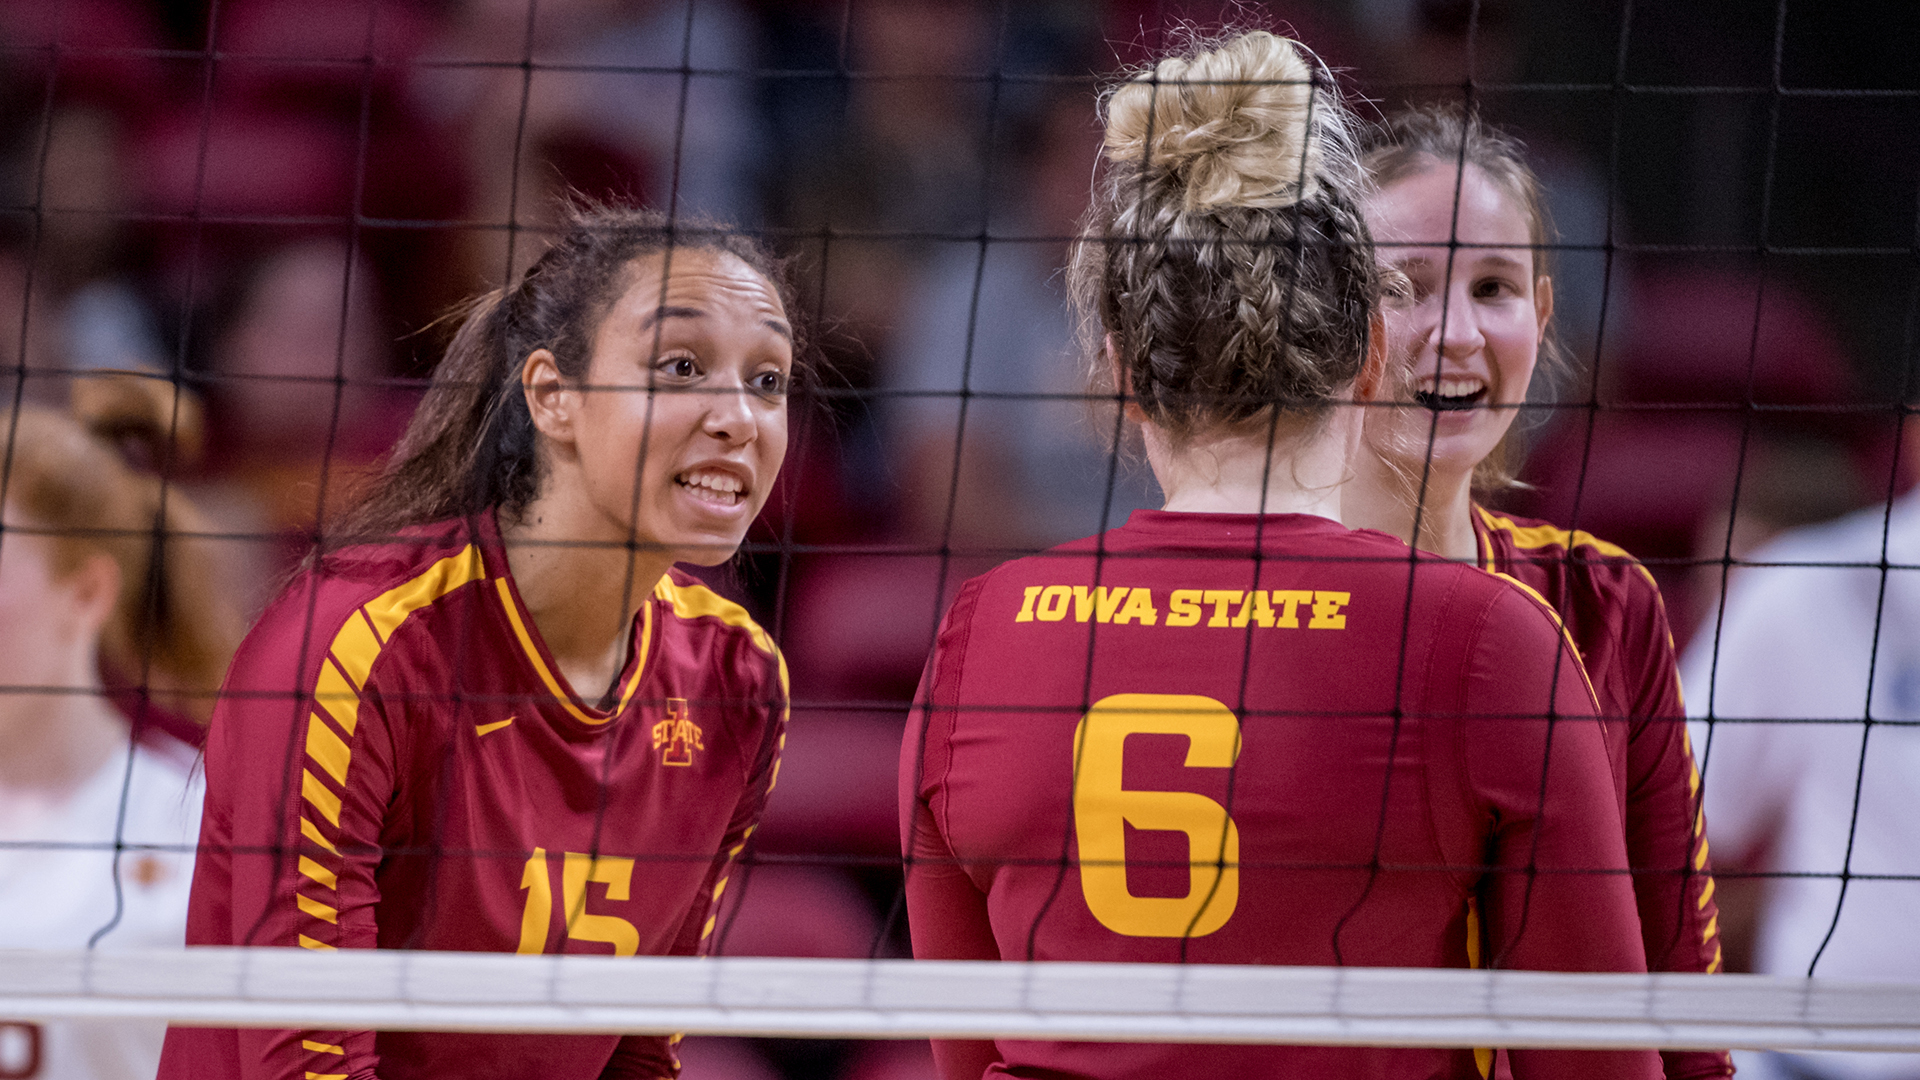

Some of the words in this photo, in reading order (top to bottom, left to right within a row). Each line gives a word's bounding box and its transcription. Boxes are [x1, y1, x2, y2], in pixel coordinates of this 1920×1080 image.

[1015, 585, 1158, 626] IOWA
[1165, 589, 1351, 630] STATE
[652, 719, 704, 750] STATE
[1073, 693, 1242, 938] 6
[515, 846, 640, 958] 15
